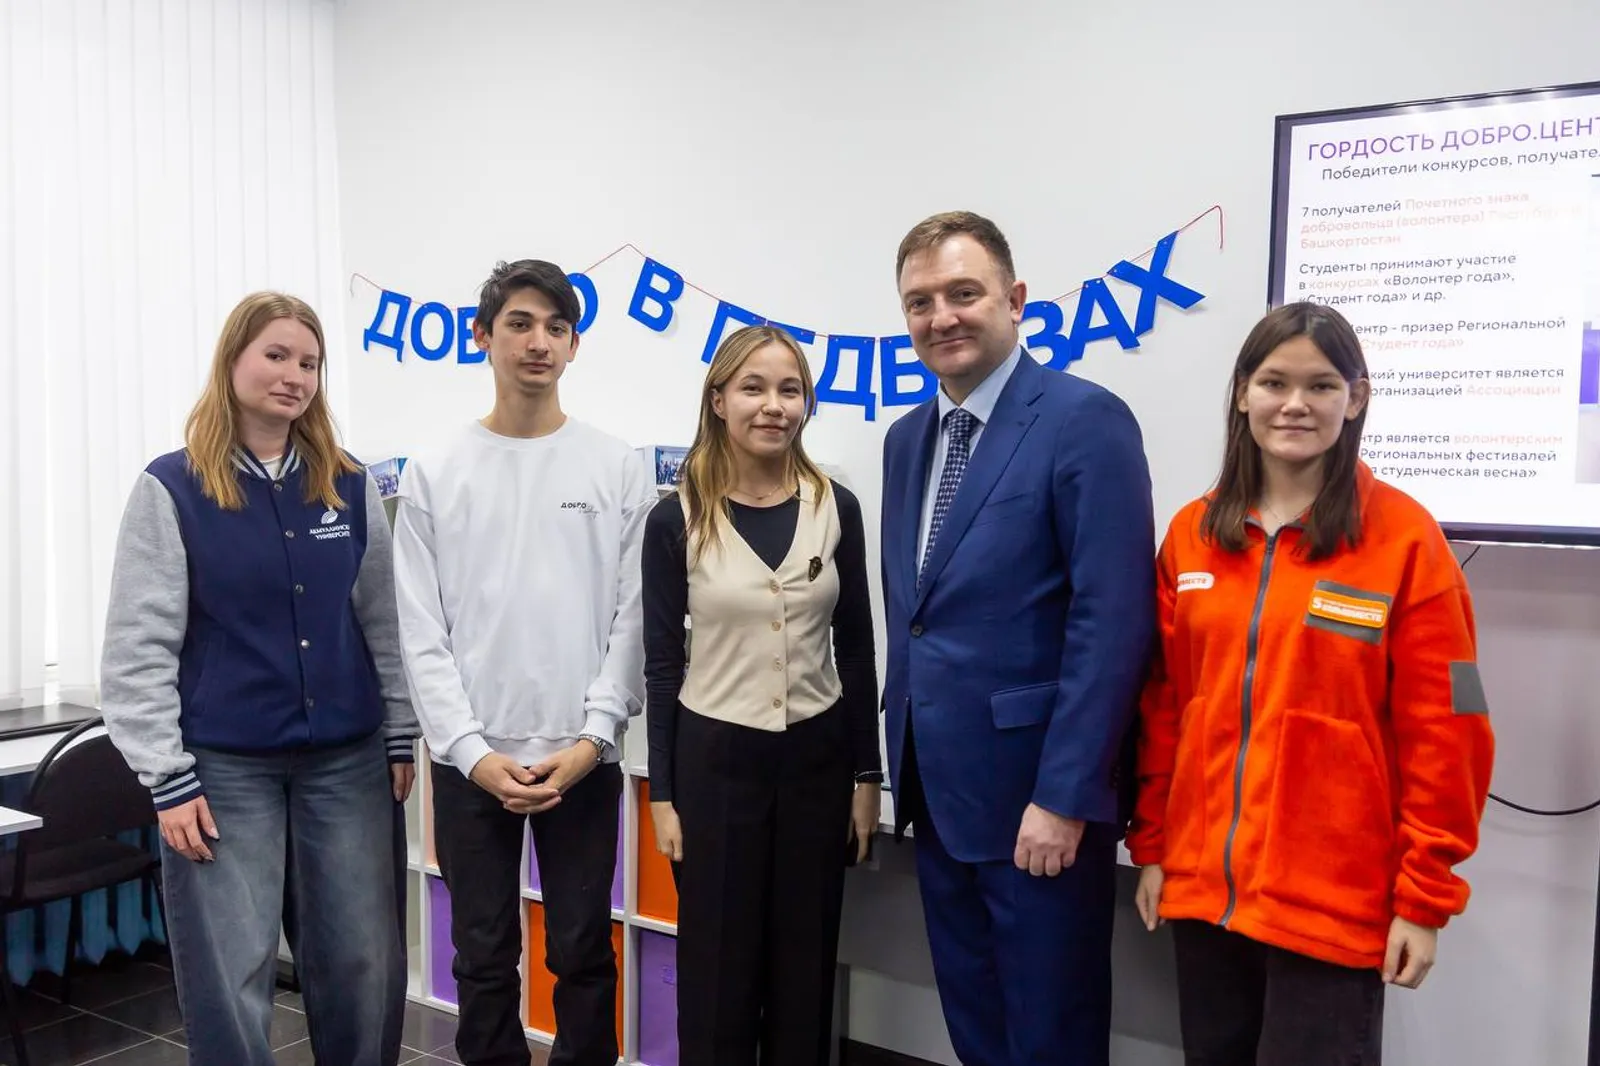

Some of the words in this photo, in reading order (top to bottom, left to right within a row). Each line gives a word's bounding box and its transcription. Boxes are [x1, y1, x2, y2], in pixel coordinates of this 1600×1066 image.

[1308, 133, 1435, 161] ГОРДОСТЬ
[1441, 116, 1600, 152] ДОБРО.ЦЕН
[1322, 159, 1417, 180] Победители
[1422, 153, 1513, 176] конкурсов,
[1517, 147, 1600, 166] получате
[1302, 207, 1309, 218] 7
[1311, 200, 1401, 219] получателей
[1299, 260, 1367, 277] Студенты
[1370, 256, 1453, 273] принимают
[1456, 252, 1517, 269] участие
[1299, 281, 1306, 290] в
[1309, 278, 1380, 292] конкурсах
[1384, 272, 1463, 288] «Волонтер
[1366, 291, 1408, 304] года»
[1412, 292, 1421, 301] и
[1424, 290, 1447, 305] др.
[363, 272, 599, 363] ДОБО
[628, 256, 685, 332] В
[1401, 322, 1454, 335] призер
[1457, 316, 1567, 331] Региональной
[1398, 368, 1492, 383] университет
[1495, 367, 1565, 380] является
[1466, 384, 1563, 399] Ассоциации
[1386, 433, 1450, 445] является
[1454, 432, 1563, 447] волонтерским
[1361, 447, 1462, 460] Региональных
[1466, 448, 1557, 464] фестивалей
[1381, 466, 1480, 479] студенческая
[1484, 467, 1538, 480] весна»
